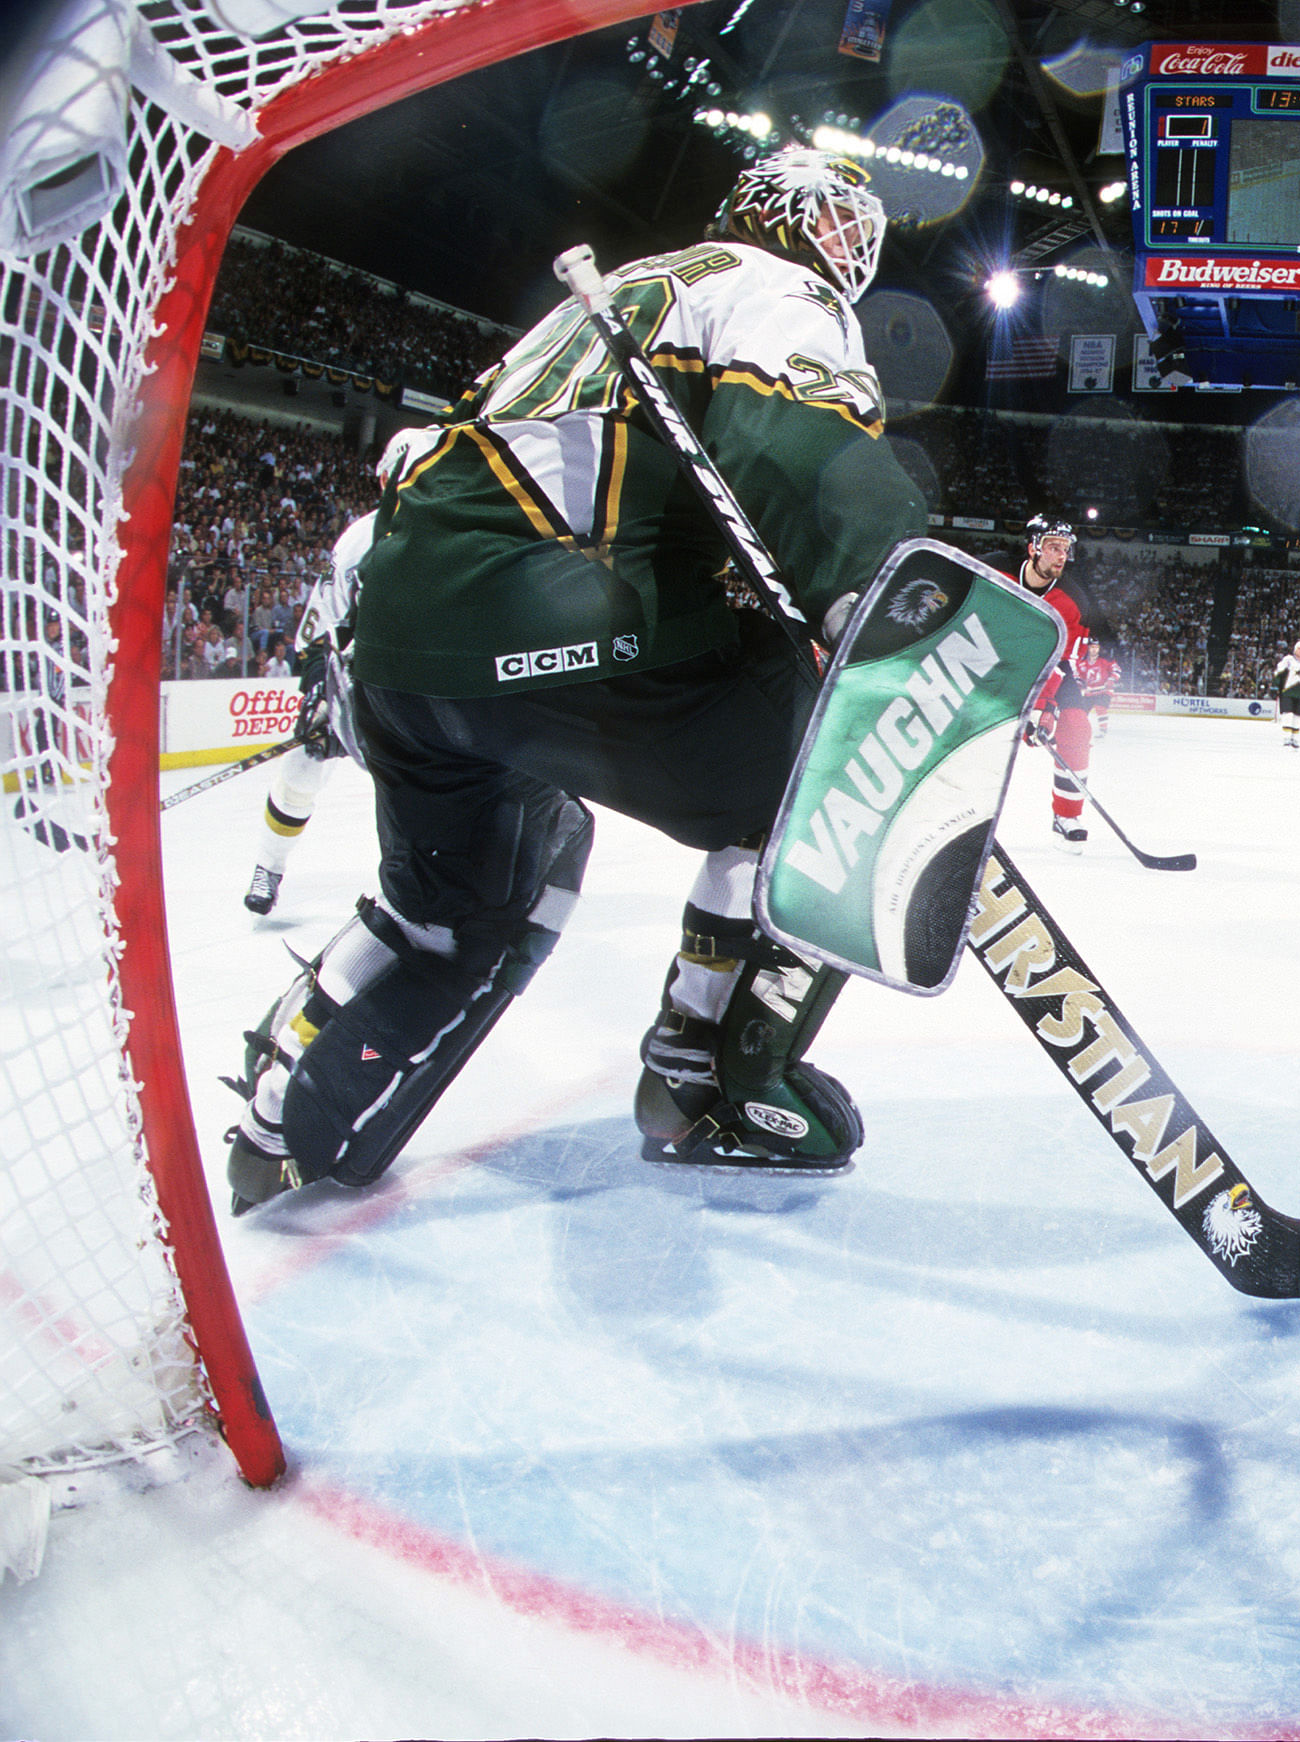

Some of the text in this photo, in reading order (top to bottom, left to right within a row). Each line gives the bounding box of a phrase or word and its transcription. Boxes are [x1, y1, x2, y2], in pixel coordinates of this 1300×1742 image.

[1187, 46, 1214, 55] Enjoy
[1175, 96, 1215, 107] STARS
[1126, 92, 1141, 211] REUNION ARENA
[1160, 221, 1178, 234] 17
[1190, 536, 1229, 544] SHARP
[615, 640, 635, 656] NHL
[500, 646, 596, 678] CCM
[785, 612, 1001, 896] VAUGHN
[968, 855, 1225, 1210] HRISTIAN
